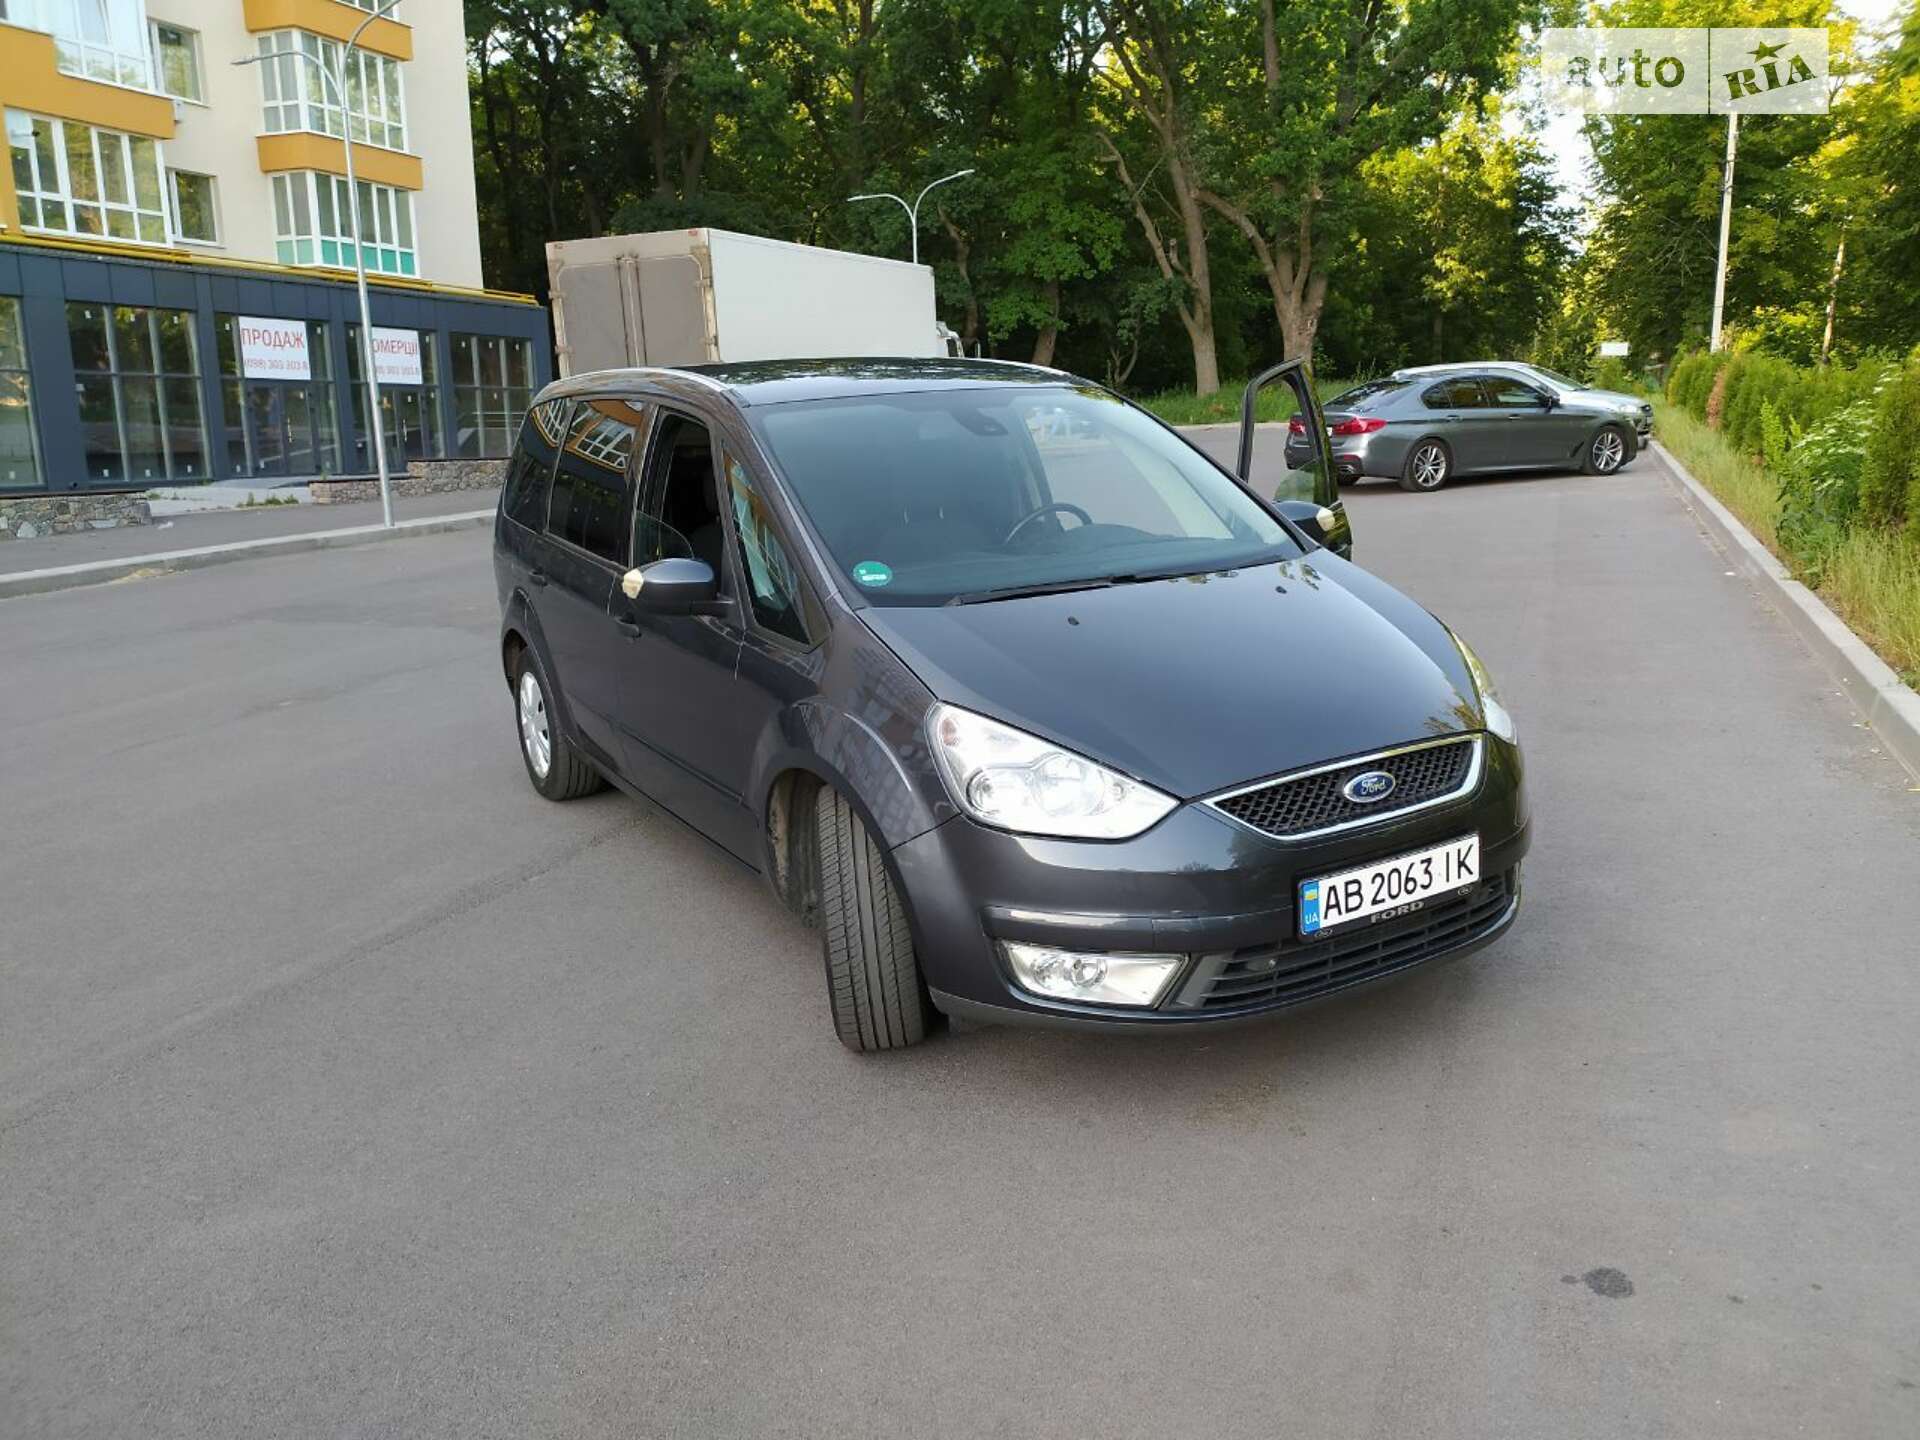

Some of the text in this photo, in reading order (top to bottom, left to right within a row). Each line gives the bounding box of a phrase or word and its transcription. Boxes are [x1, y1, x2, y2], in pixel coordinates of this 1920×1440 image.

[240, 327, 305, 350] ПРОДАЖ
[1360, 777, 1386, 795] Ford
[1322, 844, 1474, 920] AB 2063 IK
[1305, 913, 1319, 925] UA
[1370, 901, 1425, 923] FORD
